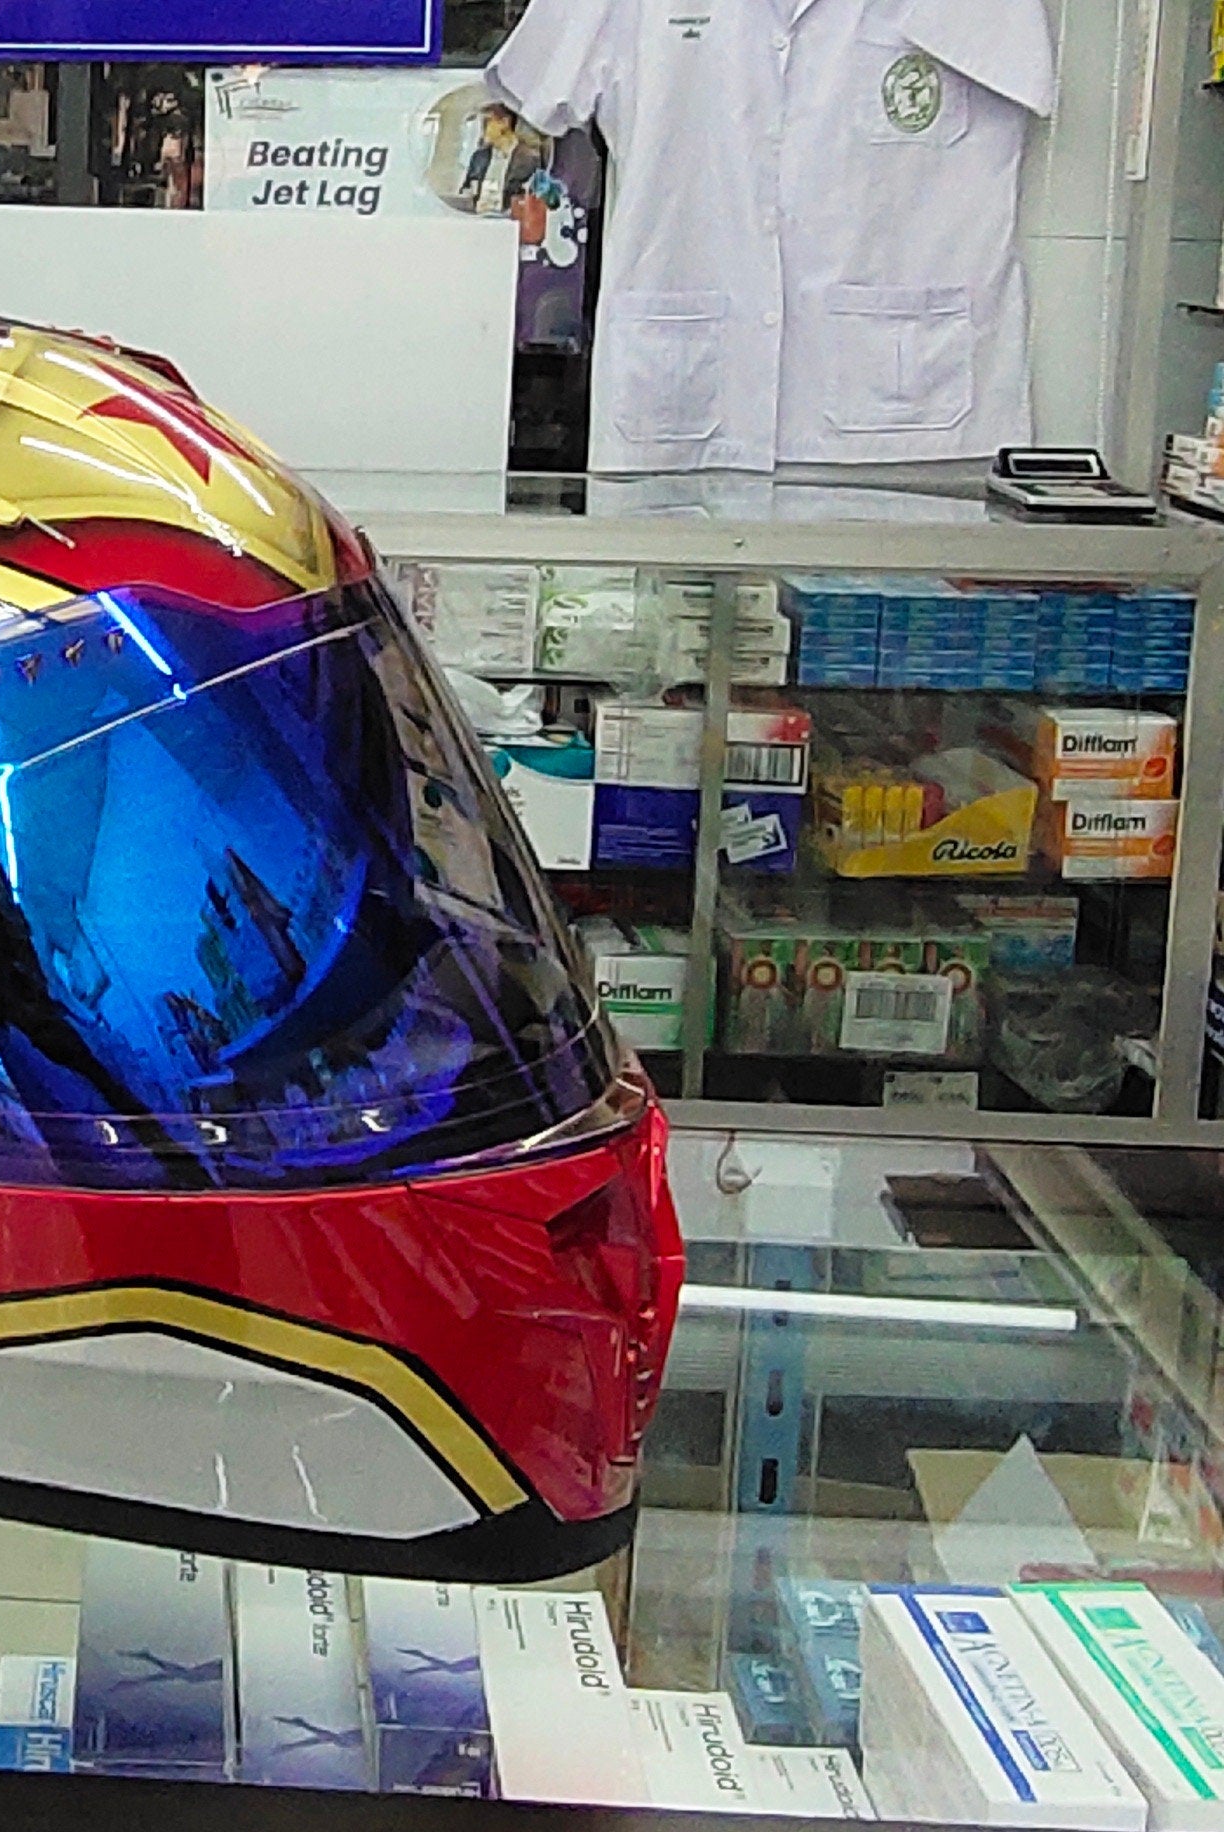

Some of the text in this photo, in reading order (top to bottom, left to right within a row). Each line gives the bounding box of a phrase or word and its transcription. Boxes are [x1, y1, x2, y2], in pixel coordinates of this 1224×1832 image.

[247, 138, 389, 177] Beating
[252, 179, 382, 216] Jet Lag
[1062, 734, 1137, 753] Difflam
[1072, 813, 1146, 831] Difflam
[932, 839, 1018, 861] Ricola
[597, 981, 673, 1001] Difflam
[563, 1600, 610, 1690] Hirudoid
[693, 1703, 744, 1792] Hirudoid
